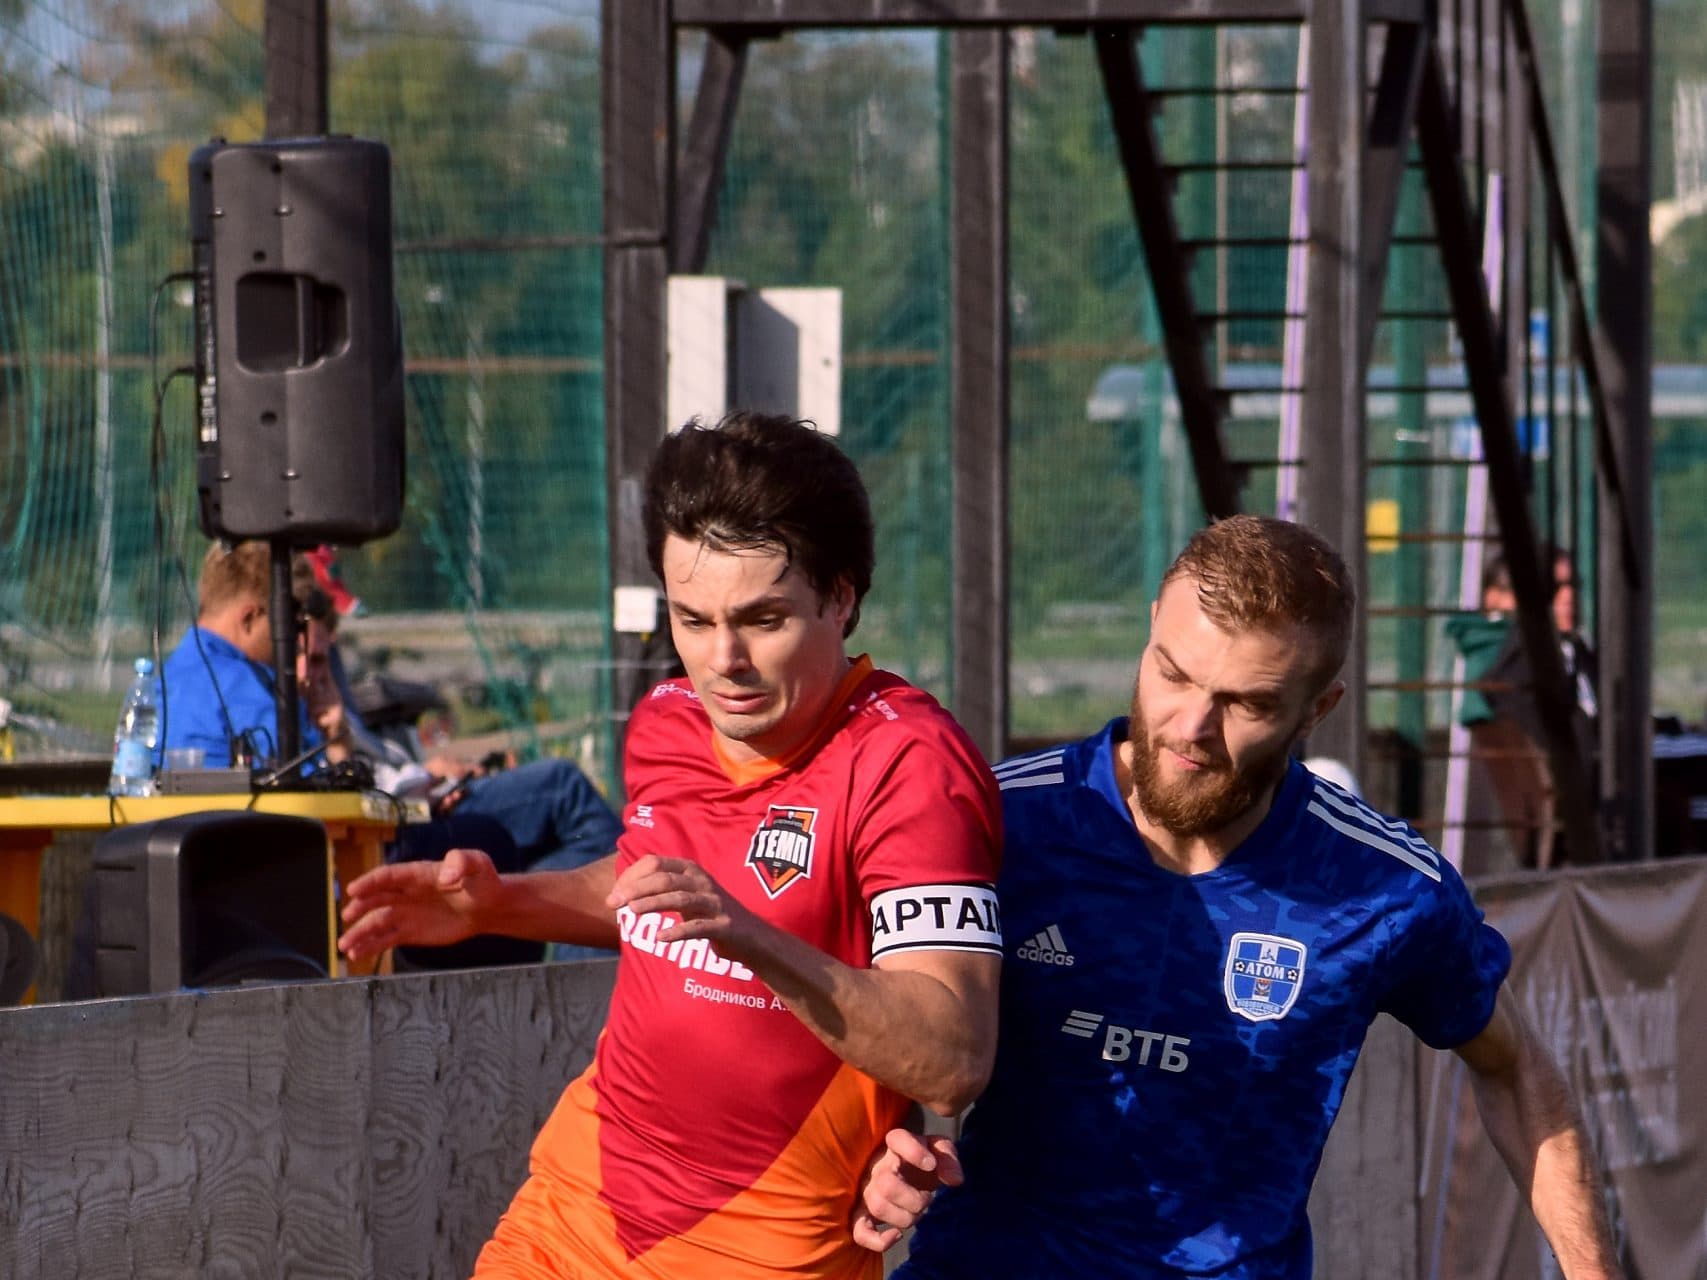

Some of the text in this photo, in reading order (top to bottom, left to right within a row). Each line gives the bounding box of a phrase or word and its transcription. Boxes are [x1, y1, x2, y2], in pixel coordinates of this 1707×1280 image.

[871, 896, 1001, 936] APTAI
[1017, 947, 1075, 966] adidas
[1245, 961, 1285, 980] АТОМ
[683, 978, 766, 1009] Бродников
[1102, 1025, 1191, 1073] ВТБ
